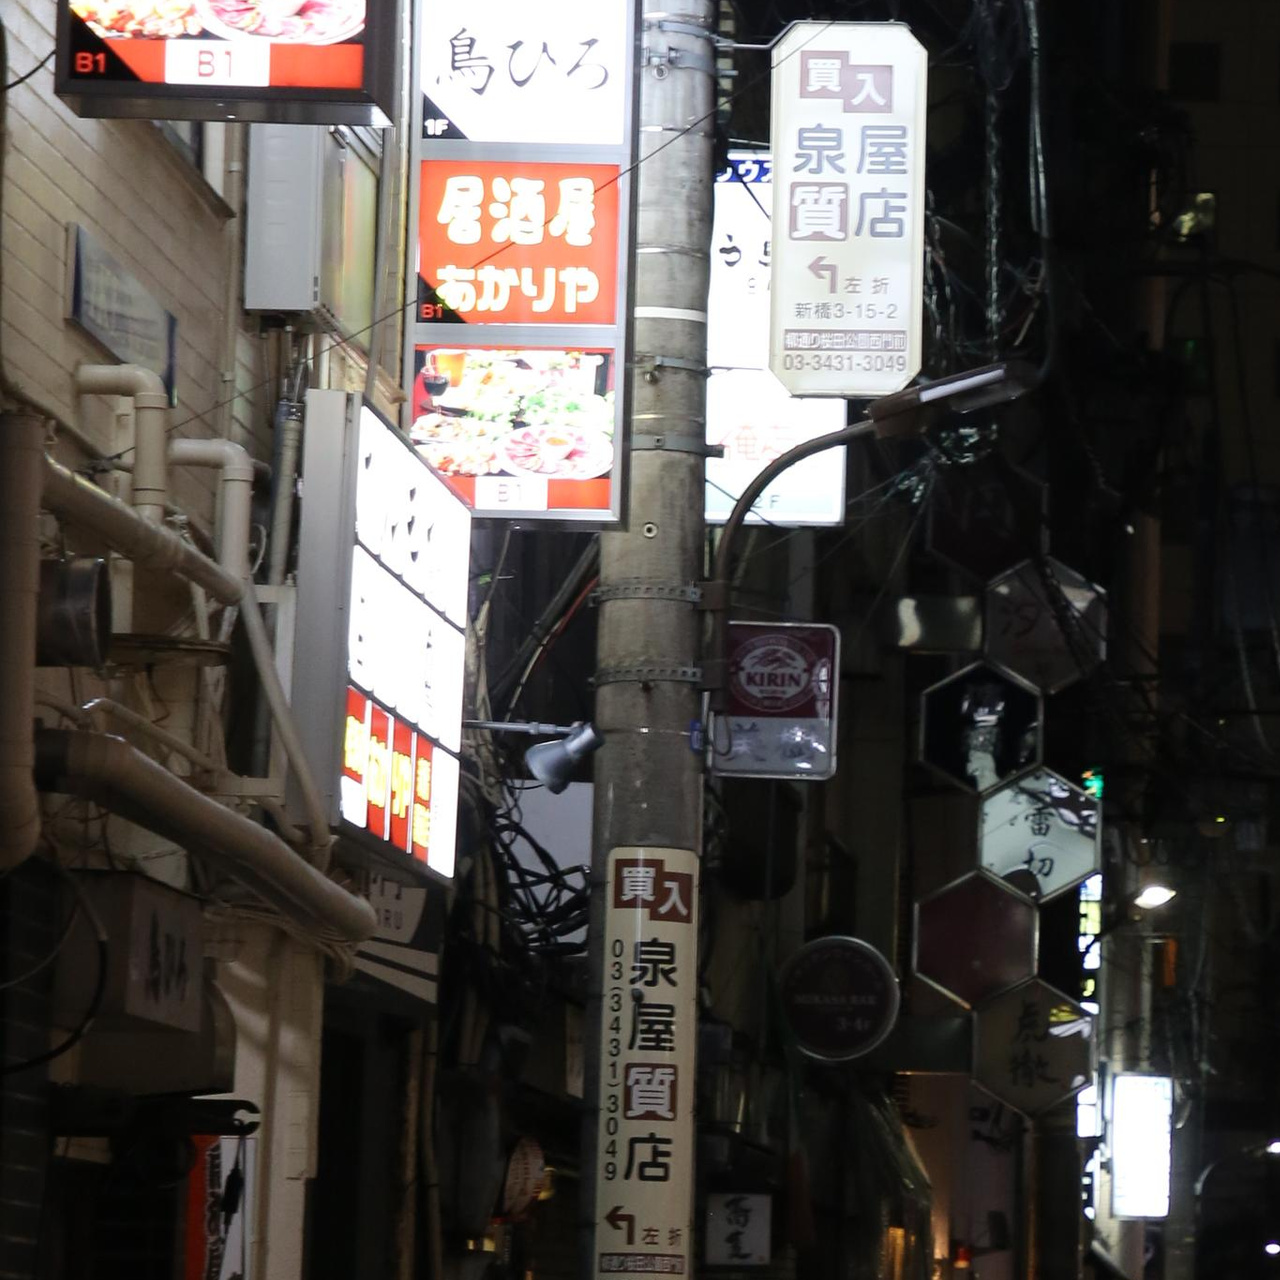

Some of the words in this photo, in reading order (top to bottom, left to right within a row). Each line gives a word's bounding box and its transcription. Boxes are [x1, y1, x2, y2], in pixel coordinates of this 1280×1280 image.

[76, 52, 106, 73] B1
[196, 49, 233, 78] B1
[435, 26, 610, 96] 鳥ひろ
[805, 57, 887, 108] 買入
[423, 117, 450, 137] 1F
[792, 123, 909, 176] 泉屋
[436, 175, 597, 246] 居酒屋
[791, 185, 909, 239] 質店
[436, 264, 600, 314] あかりや
[843, 277, 890, 295] 左折
[794, 302, 899, 320] 新橋3-15-2
[783, 353, 908, 372] 03-3431-3049
[745, 672, 801, 687] KIRIN
[620, 866, 689, 917] 買入
[623, 937, 679, 1182] 泉屋質店
[641, 1227, 683, 1246] 左折
